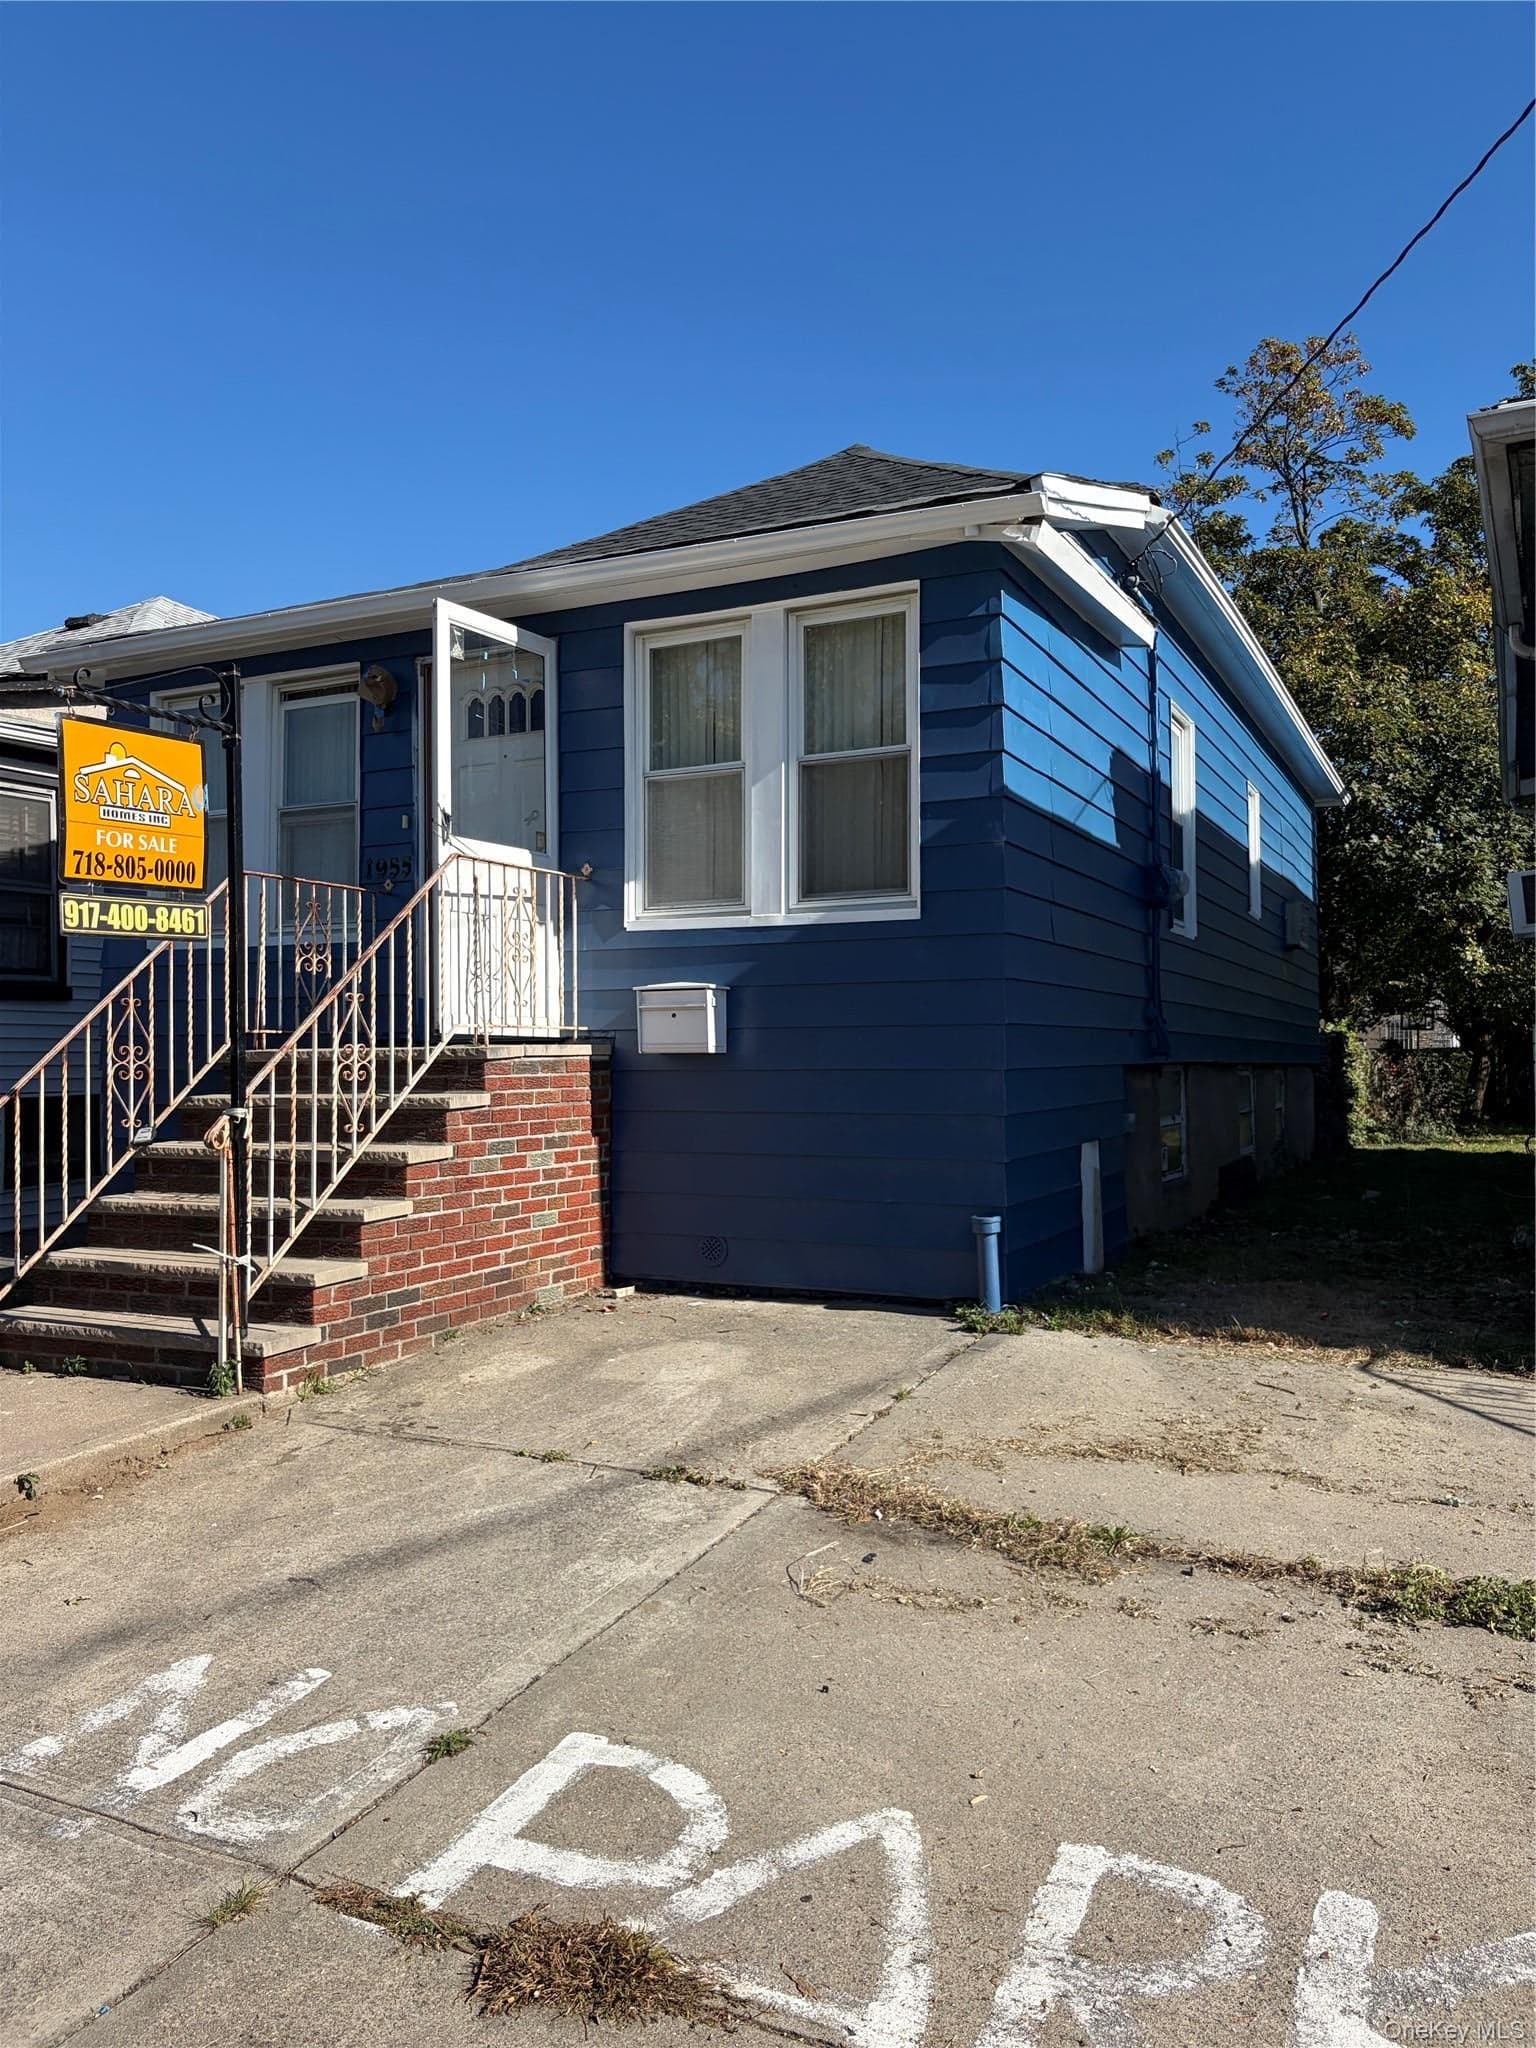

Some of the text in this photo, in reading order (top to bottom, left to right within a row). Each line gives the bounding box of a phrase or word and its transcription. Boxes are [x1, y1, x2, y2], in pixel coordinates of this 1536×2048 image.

[73, 772, 197, 818] SAHARA
[102, 808, 168, 825] HOMES INC
[95, 829, 177, 854] FOR SALE
[72, 850, 196, 884] 718-805-0000
[63, 899, 205, 934] 917-400-8461
